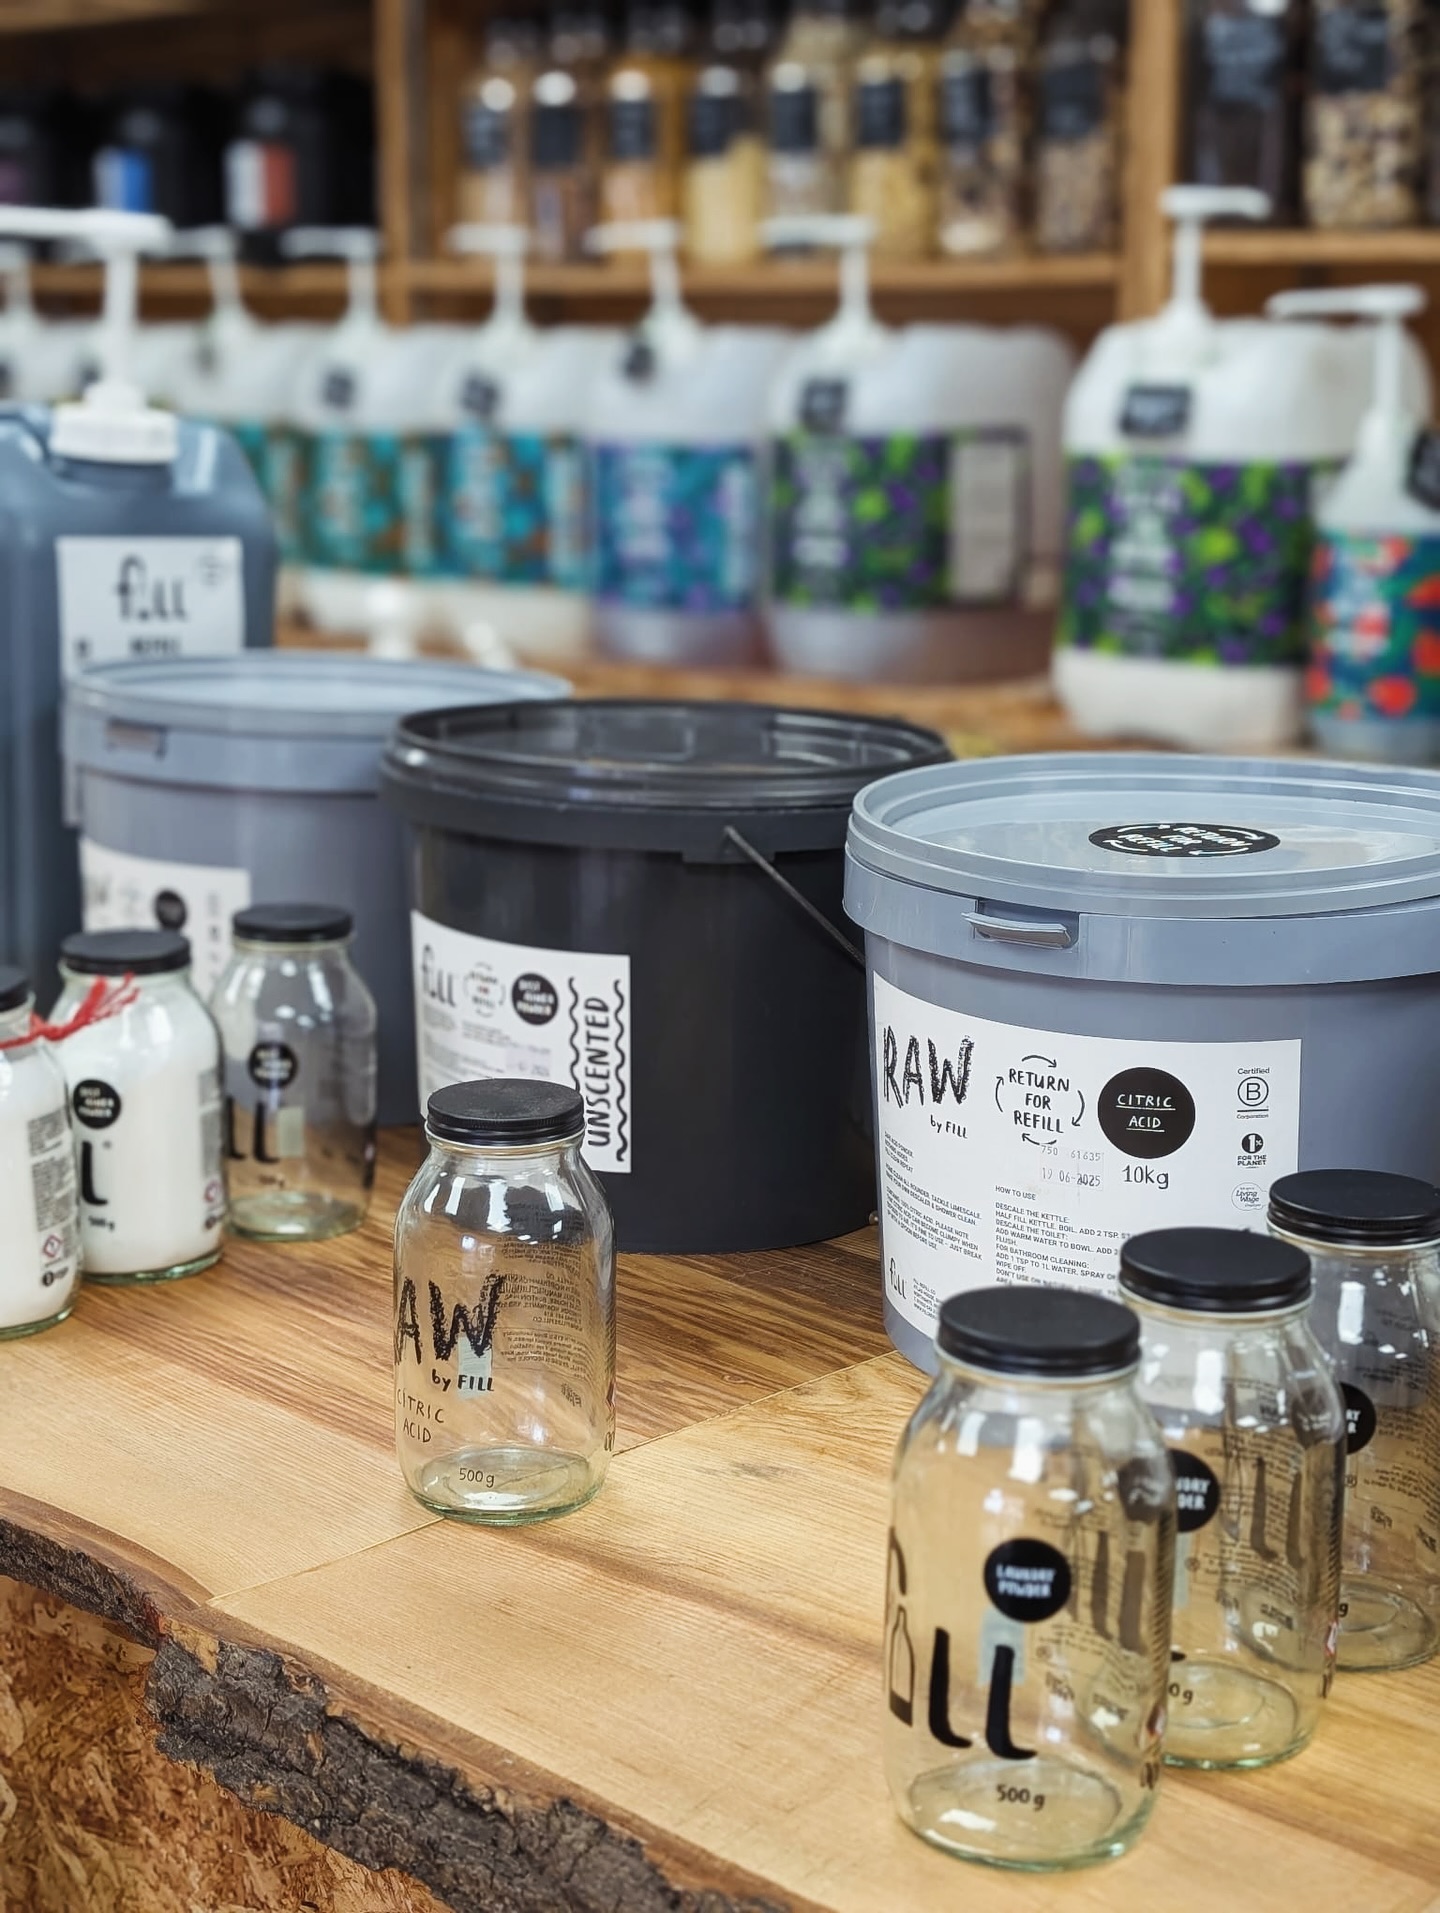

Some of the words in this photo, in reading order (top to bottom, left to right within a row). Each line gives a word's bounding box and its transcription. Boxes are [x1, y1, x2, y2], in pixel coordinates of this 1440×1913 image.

[584, 997, 611, 1148] UNSCENTED
[883, 1025, 975, 1109] RAW
[1009, 1068, 1070, 1092] RETURN
[1246, 1082, 1261, 1100] B
[1025, 1093, 1052, 1110] FOR
[1118, 1094, 1172, 1108] CITRIC
[930, 1114, 942, 1133] by
[946, 1121, 968, 1138] FILL
[1014, 1110, 1064, 1133] REFILL
[1128, 1116, 1161, 1128] ACID
[1122, 1164, 1169, 1190] 10kg
[995, 1185, 1010, 1194] HOW
[1022, 1192, 1036, 1200] USE
[996, 1202, 1024, 1214] DESCALE
[1027, 1209, 1039, 1218] THE
[996, 1210, 1012, 1219] HALF
[1014, 1215, 1027, 1224] FILL
[1059, 1225, 1077, 1234] BOIL.
[1080, 1228, 1095, 1236] ADD
[1103, 1230, 1119, 1238] TSP.
[996, 1218, 1024, 1231] DESCALE
[1027, 1226, 1039, 1235] THE
[996, 1227, 1009, 1236] ADD
[1010, 1231, 1032, 1242] WARM
[1033, 1236, 1057, 1246] WATER
[1096, 1247, 1112, 1255] ADD
[996, 1244, 1009, 1252] FOR
[1010, 1247, 1048, 1261] BATHROOM
[996, 1260, 1012, 1269] WIPE
[996, 1252, 1010, 1261] ADD
[1016, 1256, 1029, 1265] TSP
[1031, 1260, 1040, 1268] TO
[1080, 1270, 1104, 1279] SPRAY
[996, 1268, 1015, 1278] DON'T
[1016, 1273, 1029, 1281] USE
[397, 1272, 502, 1366] AW
[432, 1368, 452, 1392] by
[458, 1374, 495, 1392] FILL
[398, 1388, 444, 1424] CITRIC
[403, 1418, 432, 1443] ACID
